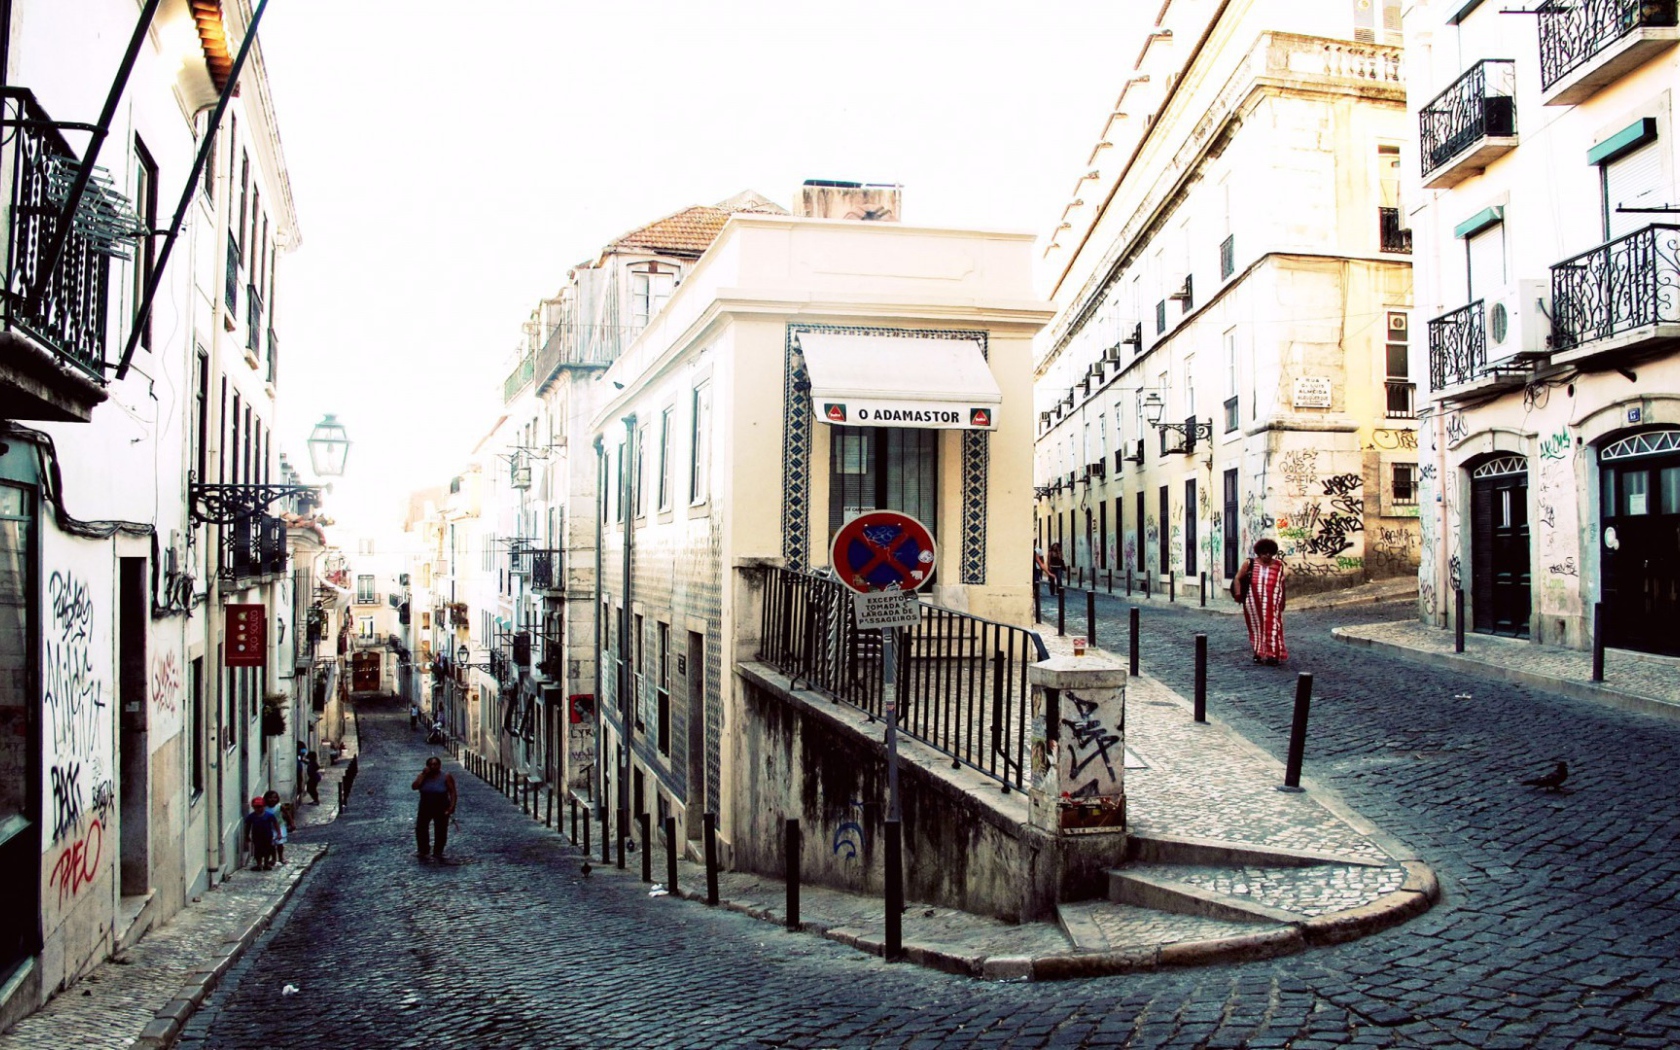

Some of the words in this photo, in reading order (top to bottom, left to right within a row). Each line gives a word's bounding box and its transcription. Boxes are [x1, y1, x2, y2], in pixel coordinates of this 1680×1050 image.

[858, 409, 868, 420] O
[874, 409, 960, 423] ADAMASTOR
[861, 609, 900, 618] LARGADA
